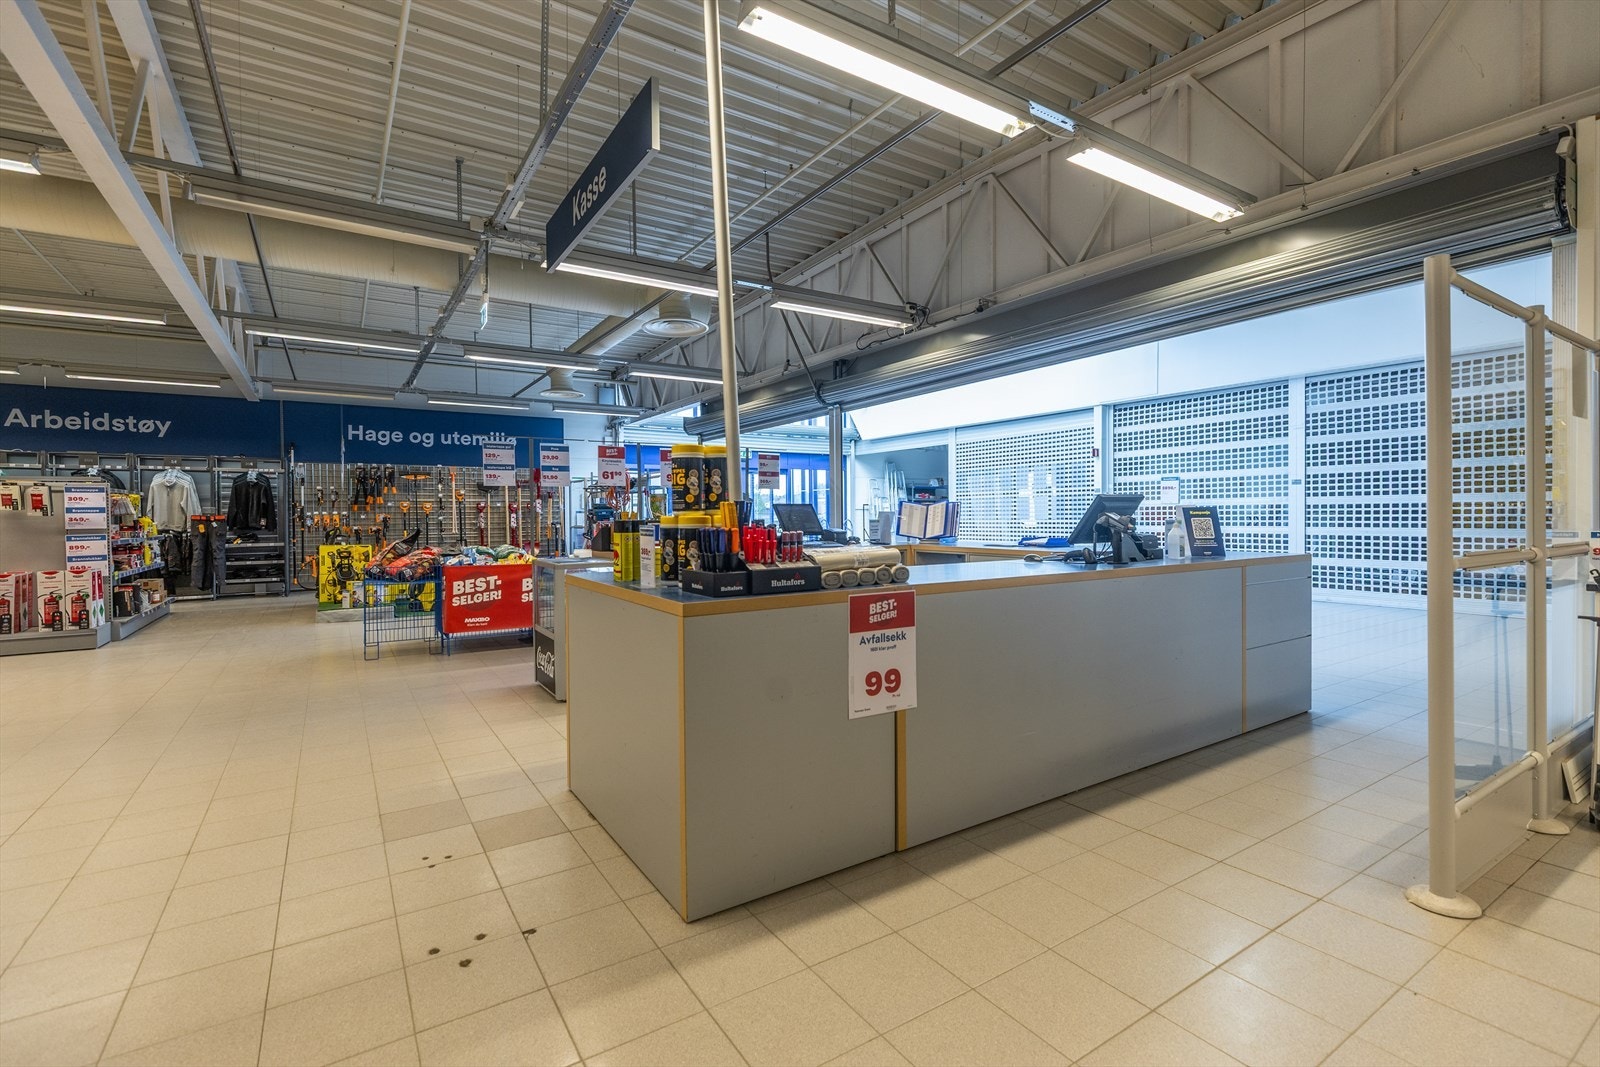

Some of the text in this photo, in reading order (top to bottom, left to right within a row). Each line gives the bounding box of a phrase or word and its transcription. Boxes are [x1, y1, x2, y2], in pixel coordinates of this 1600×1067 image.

[572, 166, 607, 226] Kasse
[3, 407, 172, 438] Arbeidstøy
[347, 424, 403, 446] Hage
[409, 431, 434, 447] og
[452, 575, 502, 595] BEST-
[771, 579, 805, 588] Hultafors
[451, 590, 502, 607] SELGER!
[868, 610, 897, 624] SELGER!
[859, 631, 907, 646] Avfallsekk
[865, 668, 902, 697] 99
